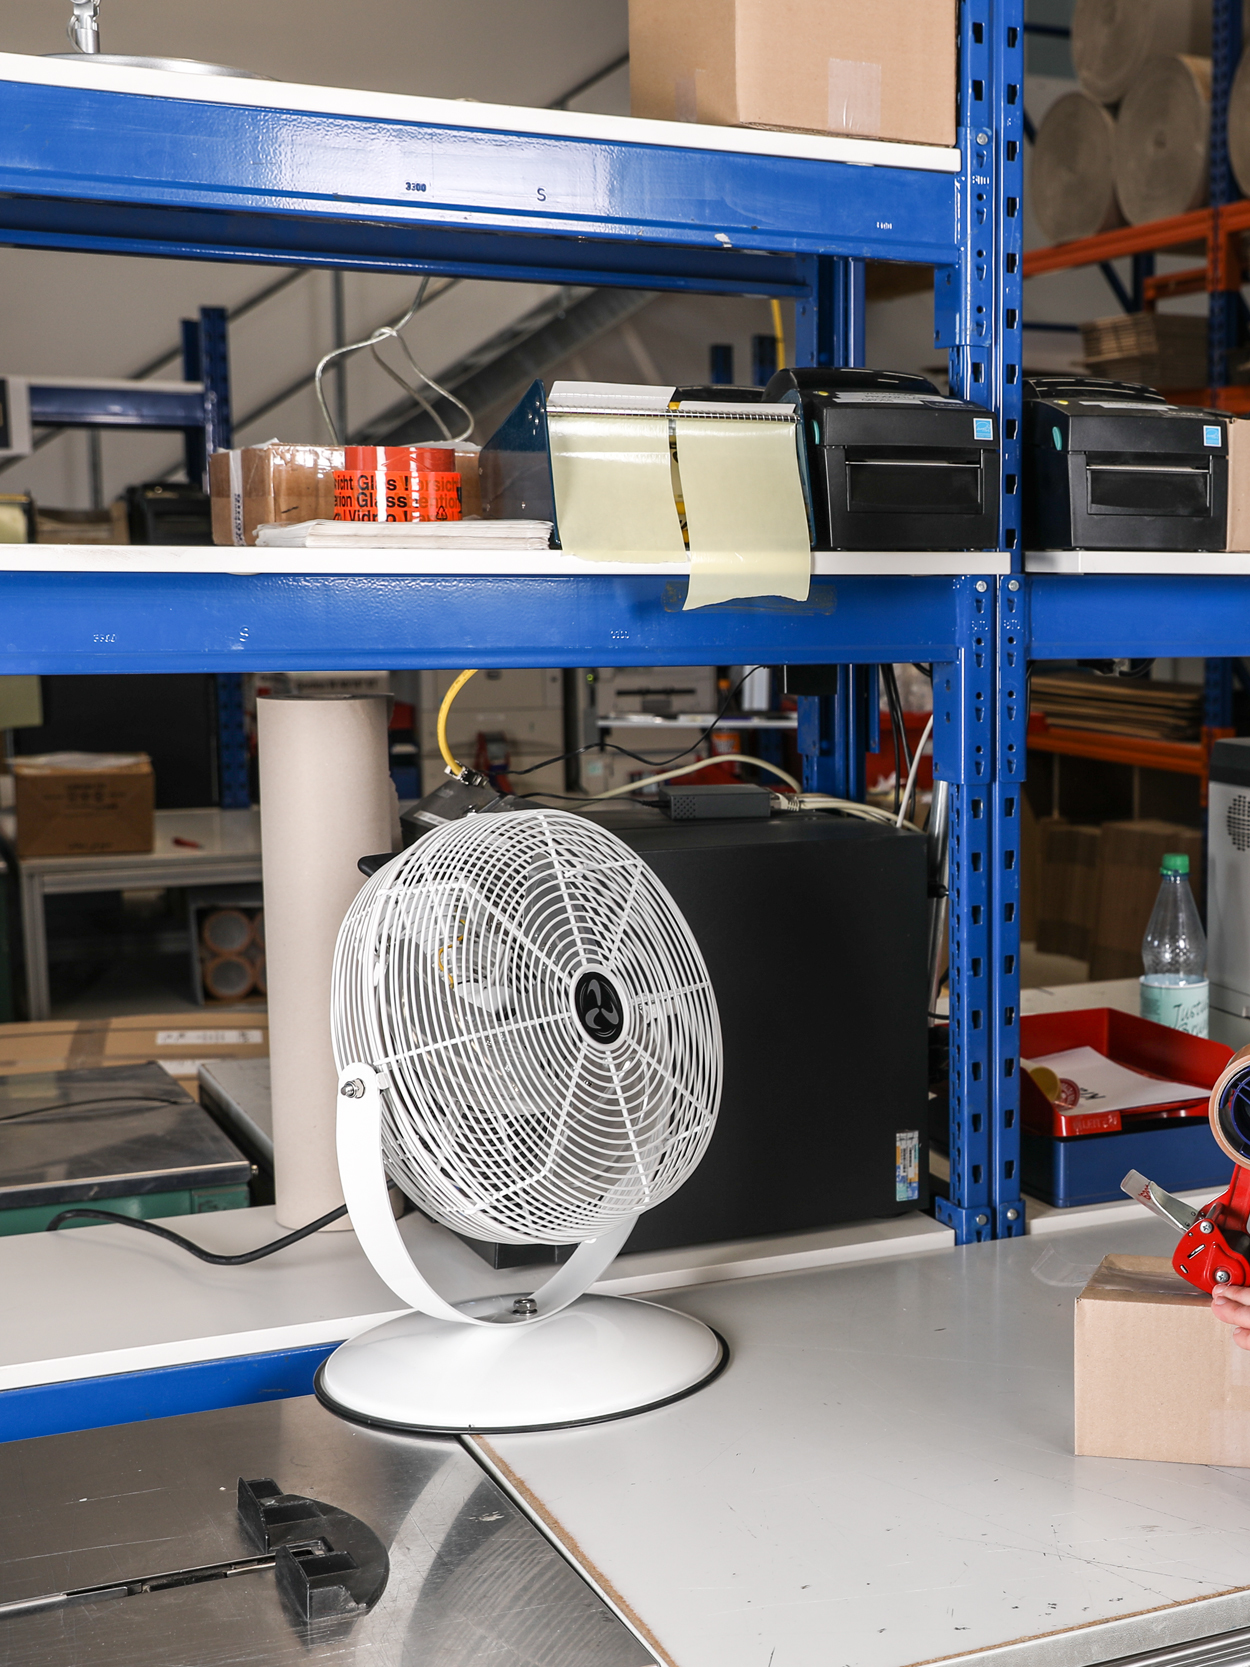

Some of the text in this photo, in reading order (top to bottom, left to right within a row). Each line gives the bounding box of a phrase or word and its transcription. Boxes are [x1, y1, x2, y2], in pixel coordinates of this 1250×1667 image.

[357, 475, 397, 491] Gls
[357, 491, 408, 508] Glss
[348, 509, 396, 522] Vidro
